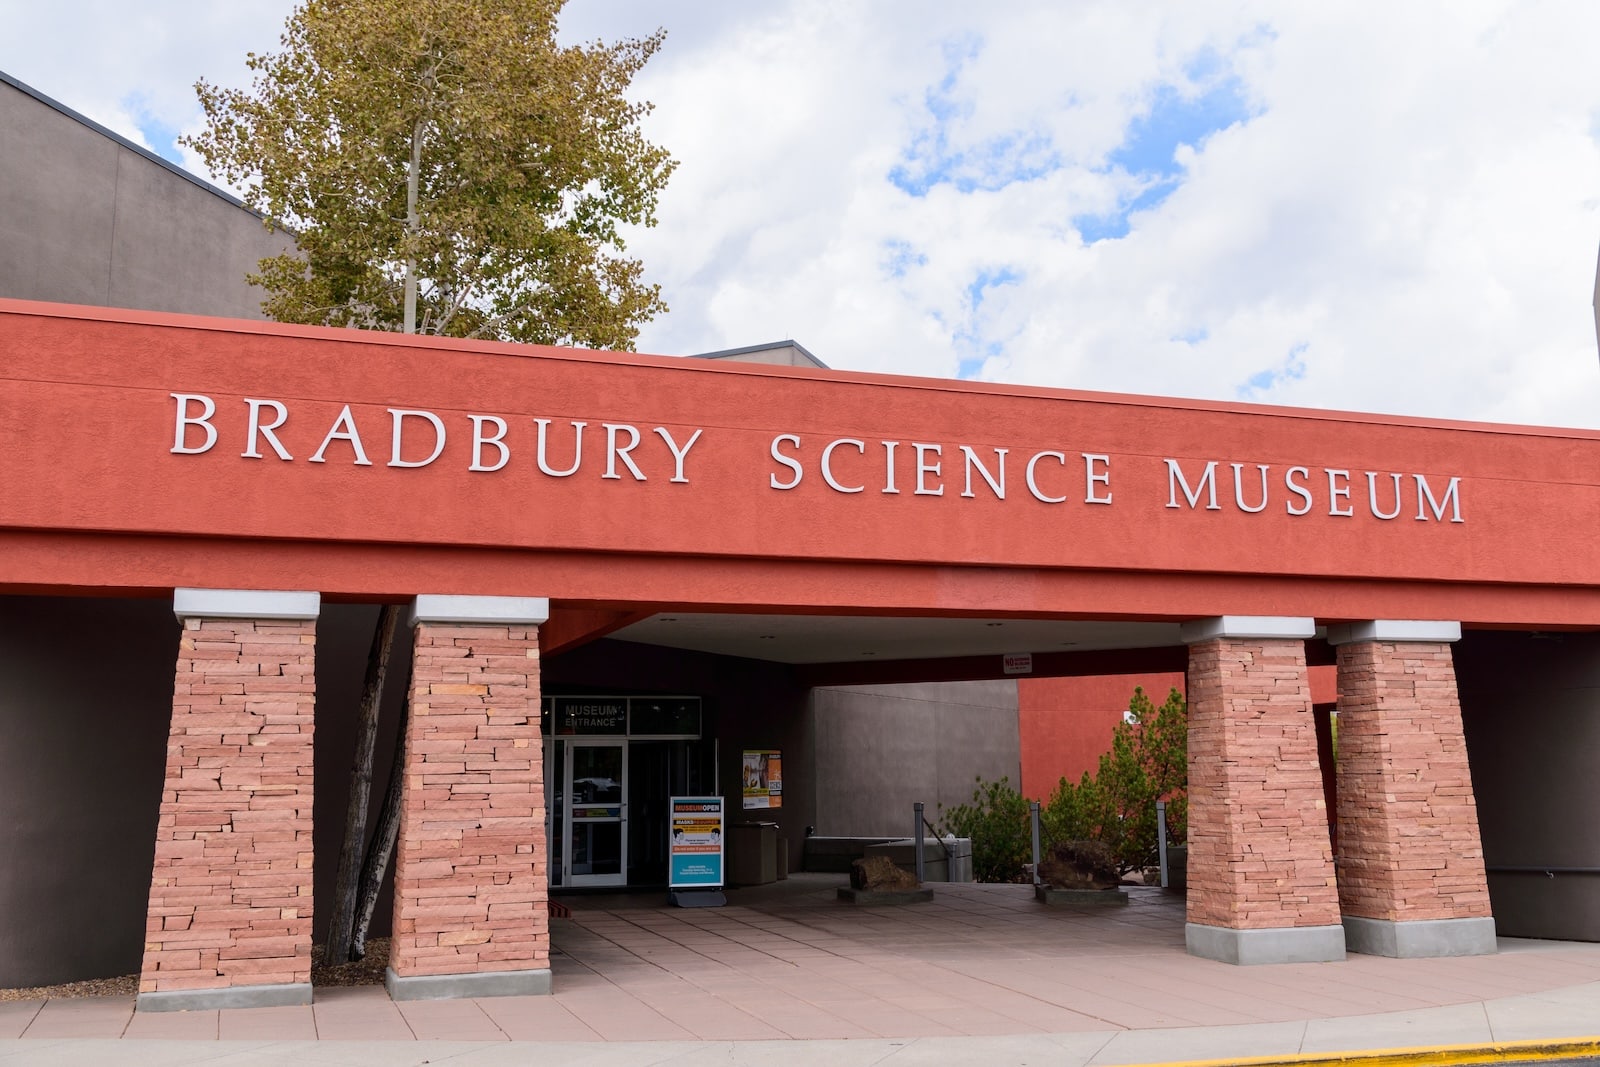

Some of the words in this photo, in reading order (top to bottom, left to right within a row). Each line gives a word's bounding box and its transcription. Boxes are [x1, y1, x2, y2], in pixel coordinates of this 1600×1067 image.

[169, 392, 703, 484] BRADBURY
[769, 434, 1113, 505] SCIENCE
[1164, 458, 1465, 525] MUSEUM
[565, 705, 616, 716] MUSEUM
[565, 719, 616, 727] ENTRANCE
